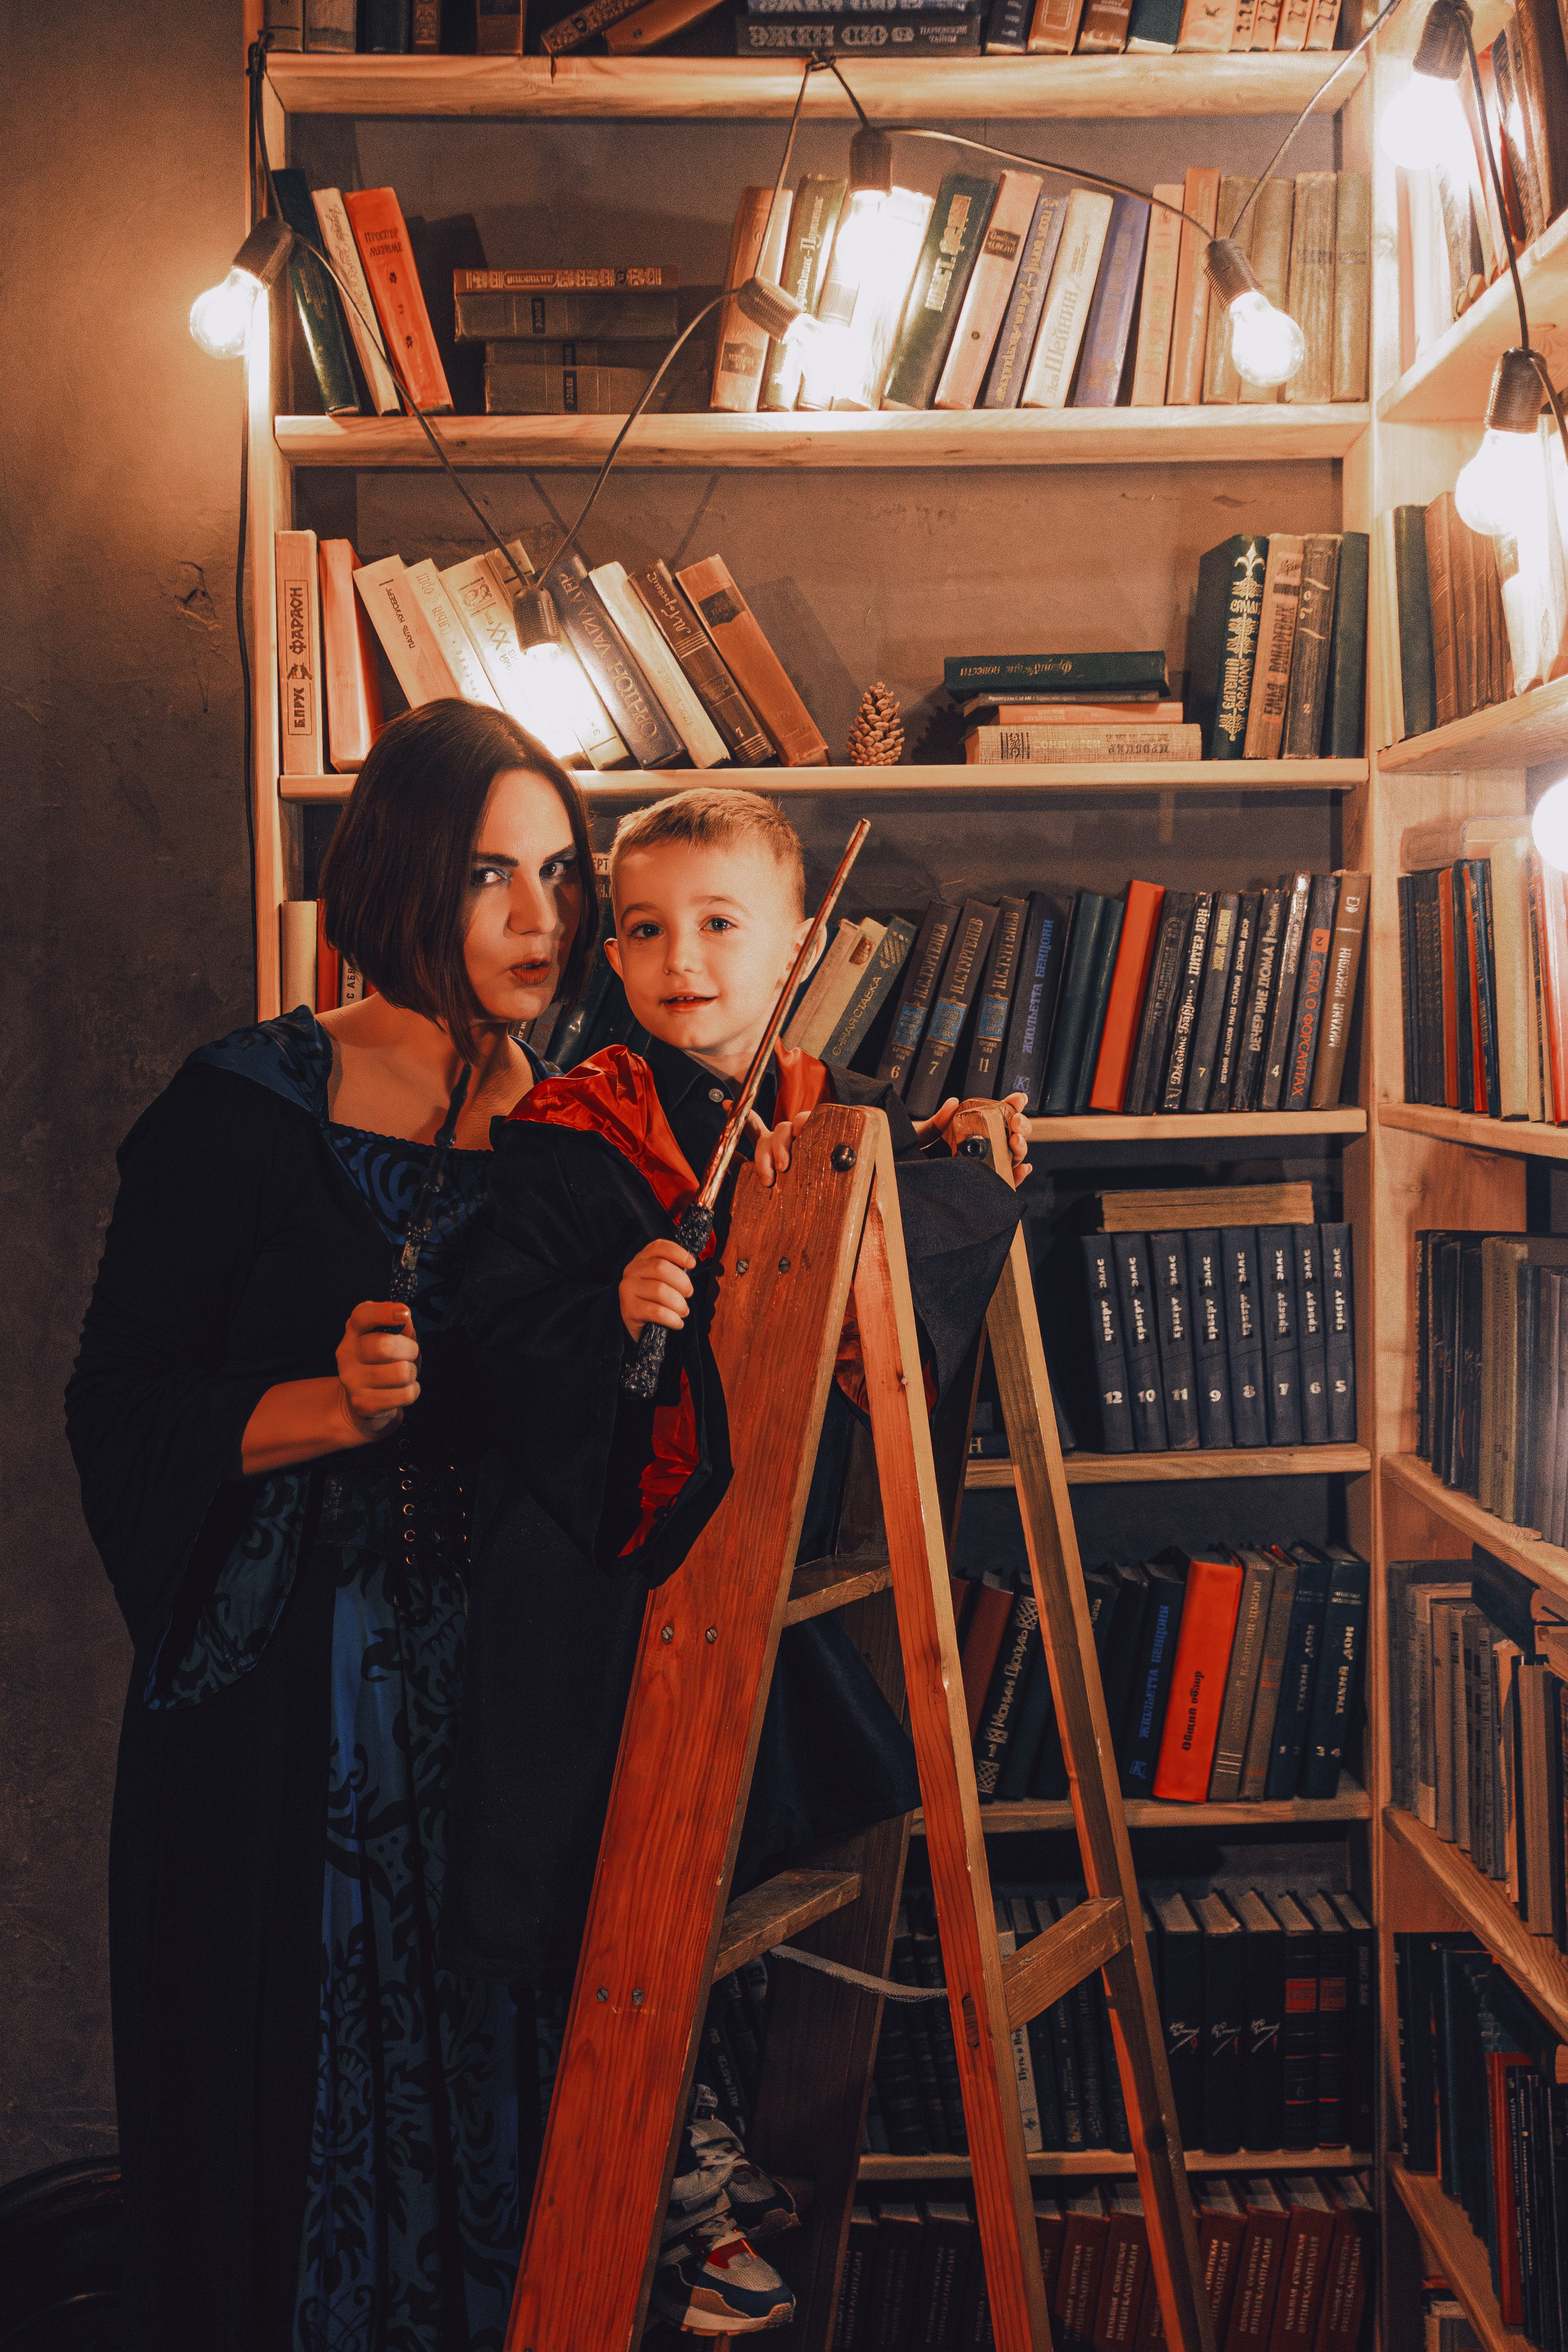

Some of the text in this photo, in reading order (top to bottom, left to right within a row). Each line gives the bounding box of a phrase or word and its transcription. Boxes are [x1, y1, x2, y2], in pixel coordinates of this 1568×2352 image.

[1046, 288, 1078, 370] Шейнин
[400, 622, 416, 649] ПАУЛЬ
[288, 587, 306, 728] Б.ПРУС ФАРАОН
[735, 726, 745, 738] 7
[1195, 908, 1209, 933] ПЭН
[913, 924, 949, 999] И.С.ТУРГЕНЕВ
[951, 918, 985, 994] И.С.ТУРГЕНЕВ
[992, 912, 1020, 990] И.С.ТУРГЕНЕВ
[1188, 935, 1204, 975] ПИТЕР
[1261, 946, 1275, 989] ДОМА
[1023, 919, 1054, 1055] ЖЮЛЬЕТТА БЕНЦОНИ
[1256, 989, 1268, 1014] ВНЕ
[1250, 1015, 1264, 1052] ВЕЧЕР
[1292, 960, 1322, 1096] САГА О ФОРСАЙТАХ
[928, 1061, 940, 1074] 7
[979, 1058, 989, 1072] 11
[1169, 1033, 1188, 1084] Джеймс
[1272, 1065, 1280, 1077] 4
[891, 1065, 900, 1079] 6
[1198, 1067, 1206, 1077] 7
[1104, 1390, 1123, 1404] 12
[1138, 1389, 1156, 1403] 10
[1173, 1388, 1188, 1401] 11
[1208, 1389, 1222, 1402] 9
[1242, 1385, 1256, 1398] 8
[1278, 1383, 1289, 1396] 7
[1310, 1381, 1321, 1394] 6
[1335, 1380, 1346, 1393] 5
[1139, 1605, 1169, 1739] ЖЮЛЬЕТТА БЕНЦОНИ
[1335, 1625, 1355, 1715] ТИХИЙ ДОН
[1182, 1670, 1205, 1751] Общий обзор
[1316, 1746, 1325, 1757] 3
[1018, 2055, 1028, 2082] Путь
